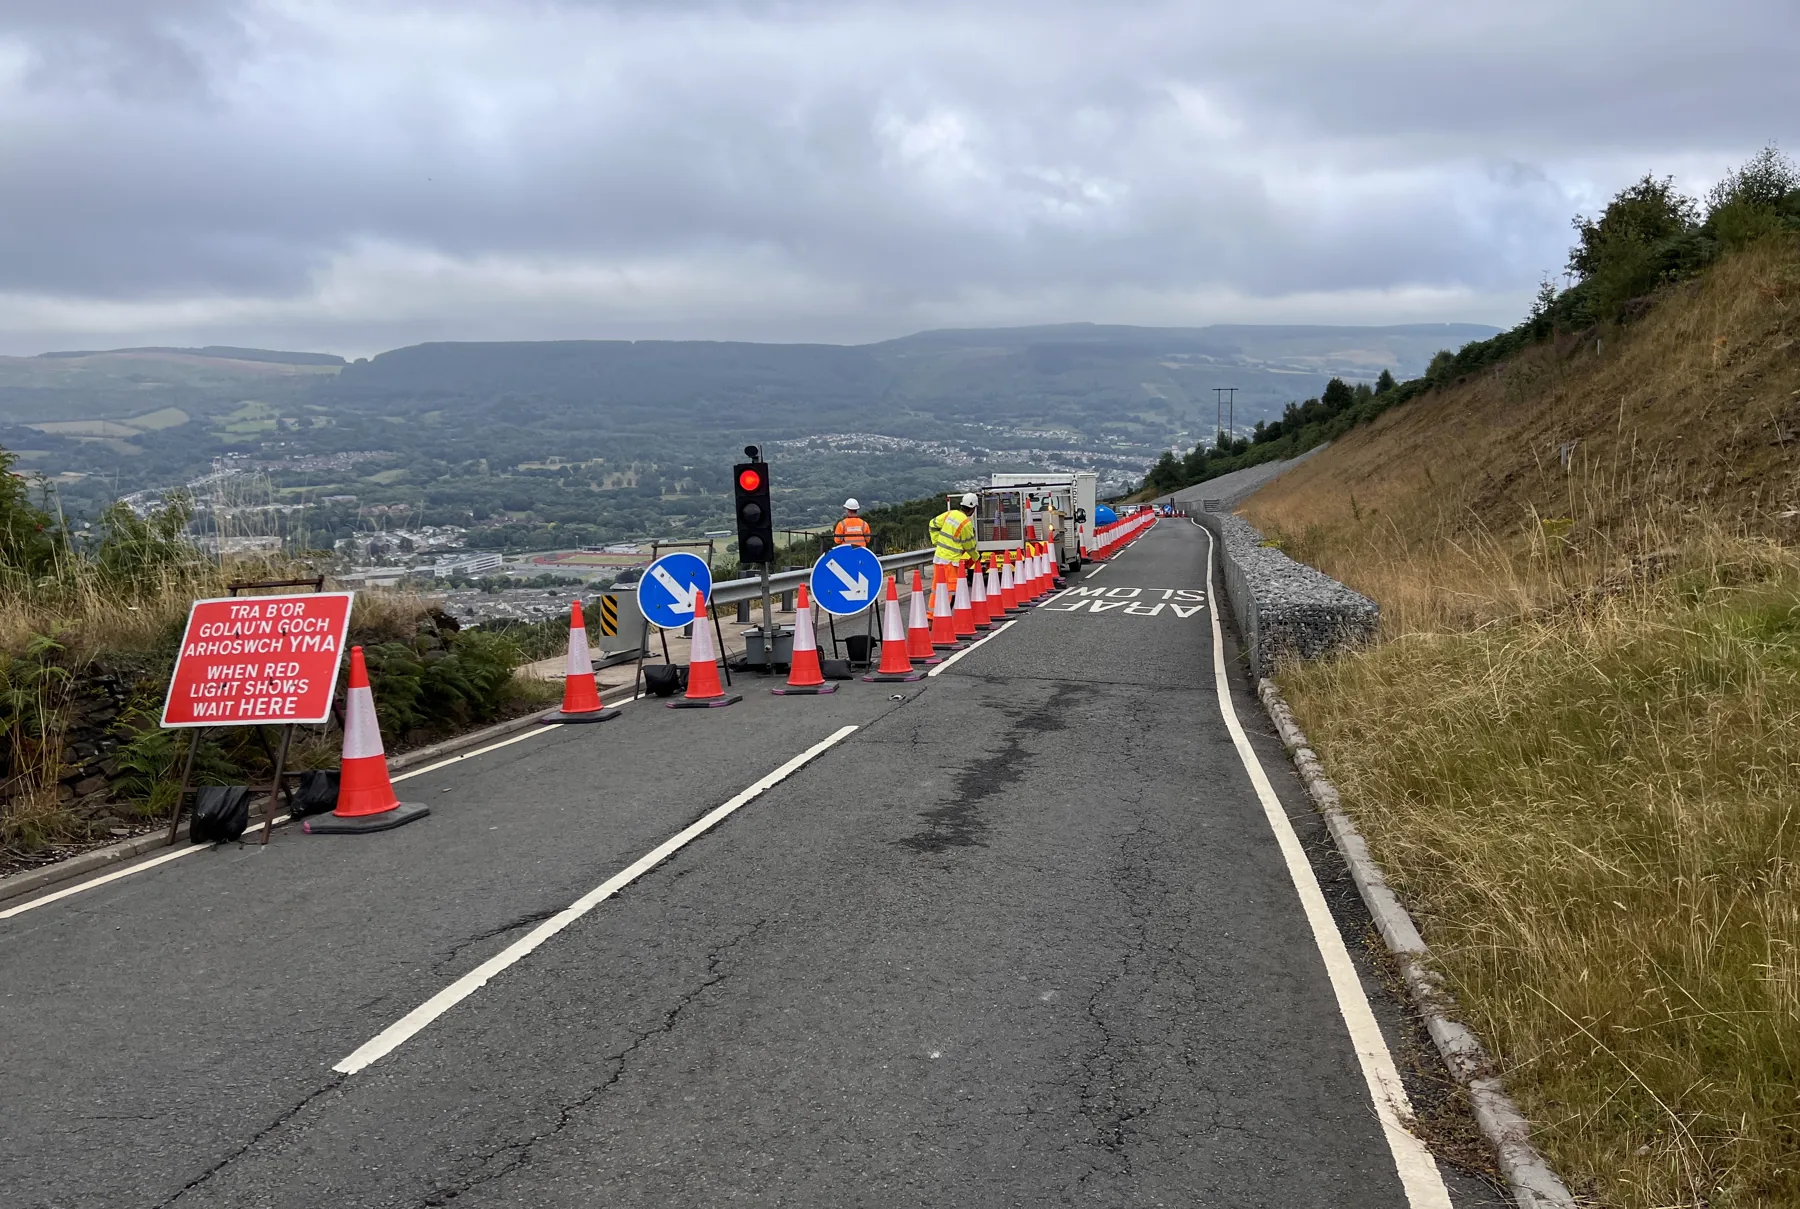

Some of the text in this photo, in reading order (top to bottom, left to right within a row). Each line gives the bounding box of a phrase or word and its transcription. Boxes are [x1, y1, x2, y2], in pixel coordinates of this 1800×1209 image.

[1066, 587, 1205, 601] SLOW
[230, 602, 305, 619] TRA B'OR
[1044, 599, 1205, 618] ARAF
[199, 618, 329, 638] GOLAU'N GOCH
[184, 634, 335, 657] ARHOSWCH YMA
[207, 662, 299, 680] WHEN RED
[190, 678, 309, 698] LIGHT SHOWS
[193, 697, 298, 717] WAIT HERE
